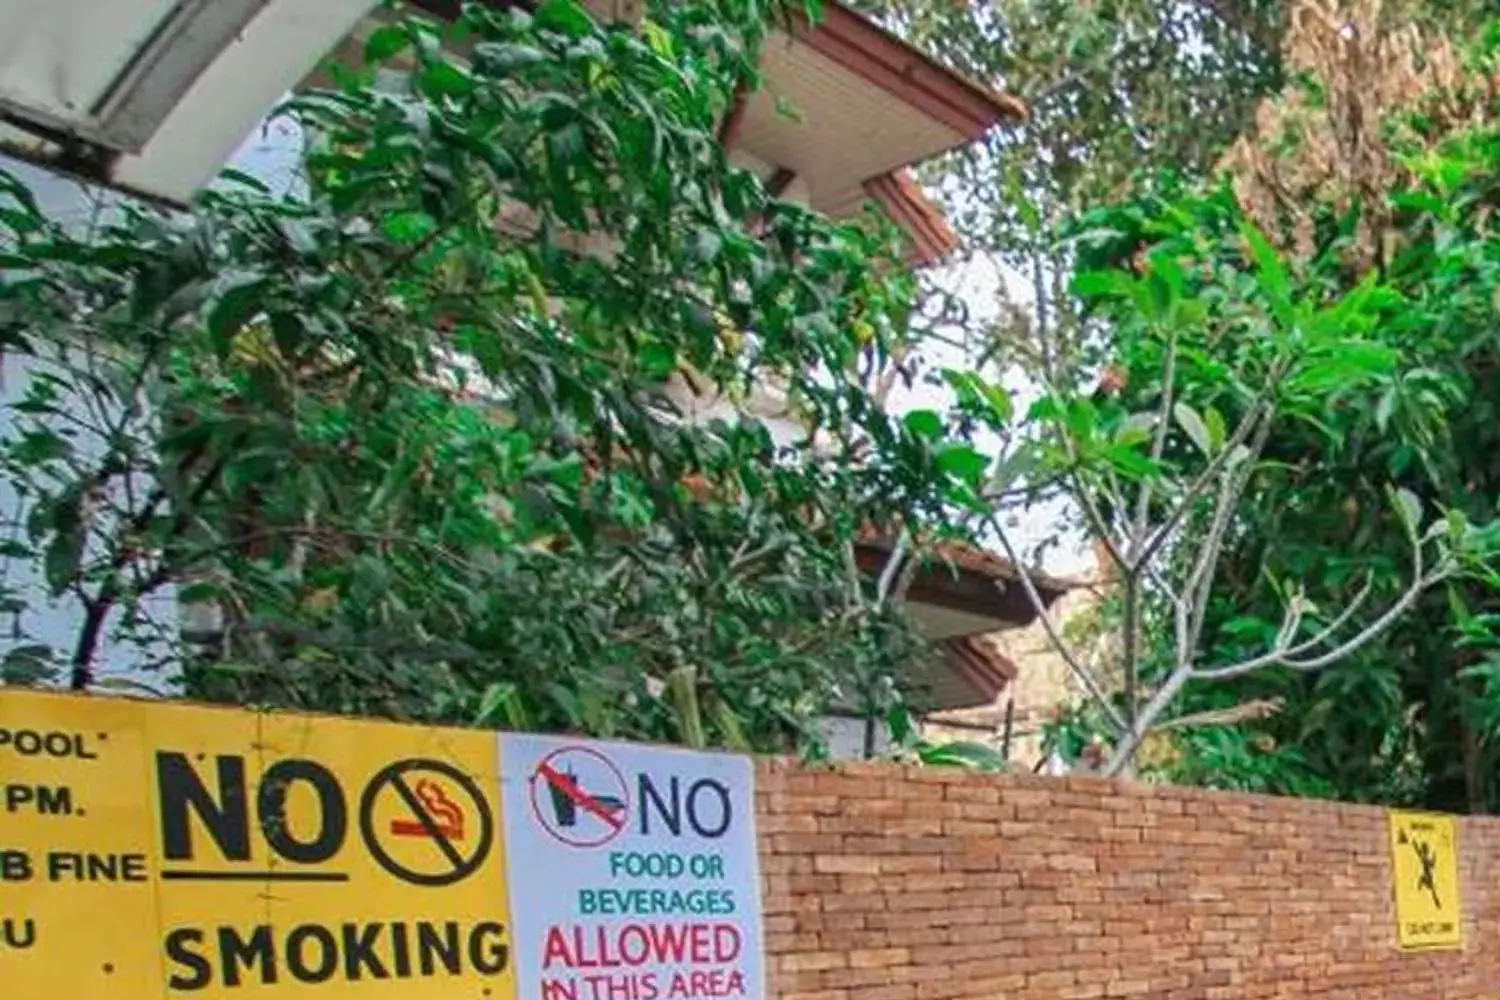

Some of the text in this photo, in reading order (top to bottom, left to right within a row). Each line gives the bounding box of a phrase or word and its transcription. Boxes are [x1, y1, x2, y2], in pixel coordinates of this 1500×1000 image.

[5, 784, 87, 818] PM.
[156, 751, 348, 864] NO
[636, 772, 733, 838] NO
[46, 852, 148, 882] FINE
[610, 852, 725, 879] FOOD OR
[578, 889, 737, 915] BEVERAGES
[164, 921, 510, 992] SMOKING
[541, 923, 742, 969] ALLOWED
[667, 970, 747, 1000] AREA
